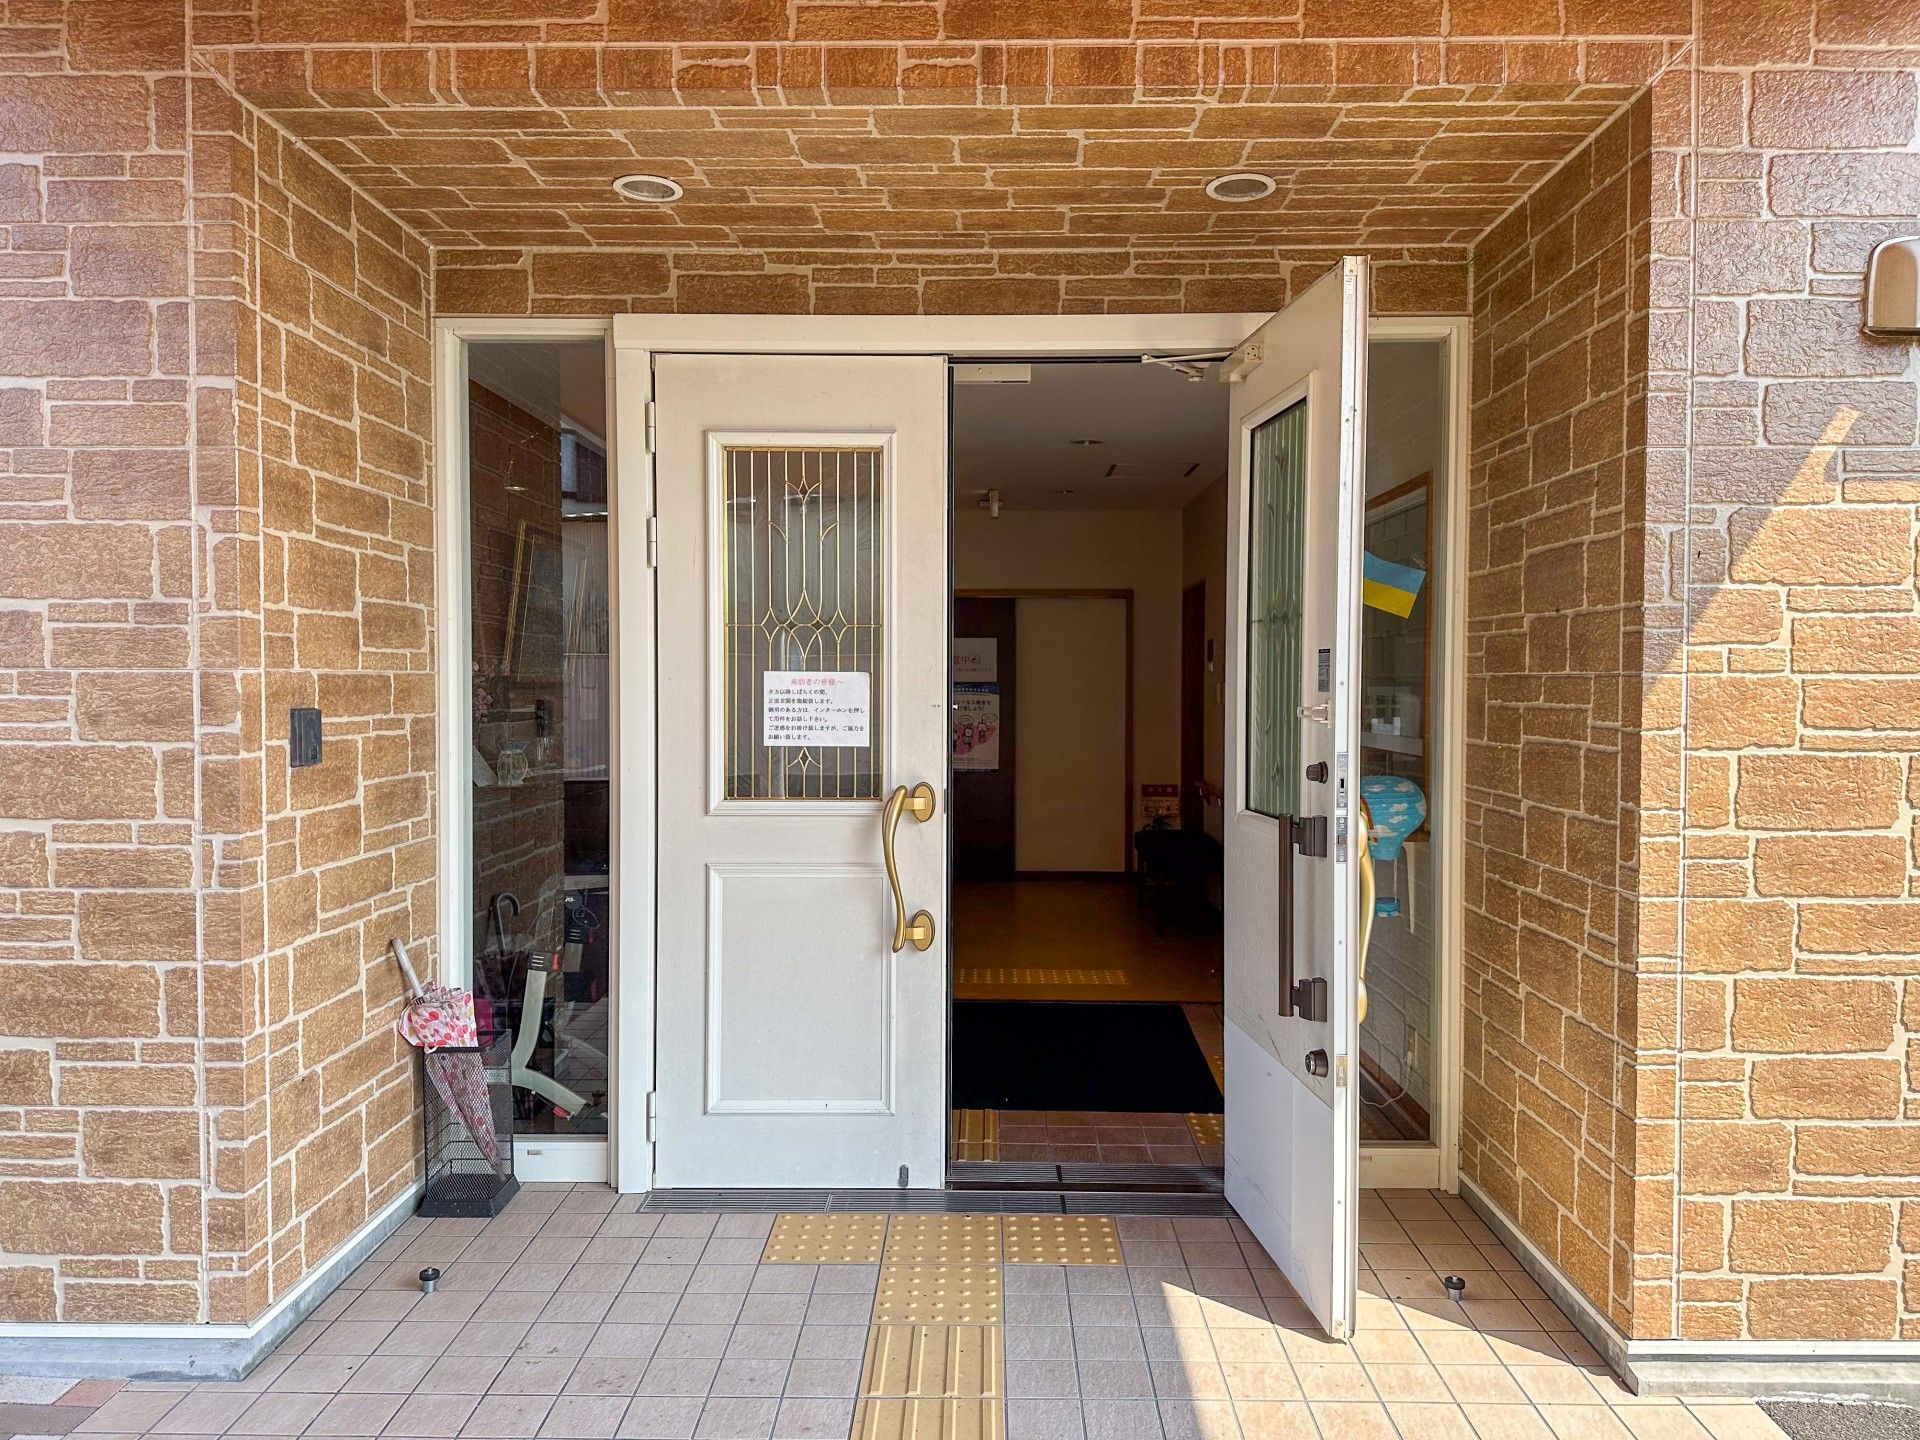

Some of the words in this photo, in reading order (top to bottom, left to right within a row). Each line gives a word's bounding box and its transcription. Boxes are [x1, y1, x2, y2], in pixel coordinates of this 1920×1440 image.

[791, 678, 844, 686] 来訪者の皆様へ
